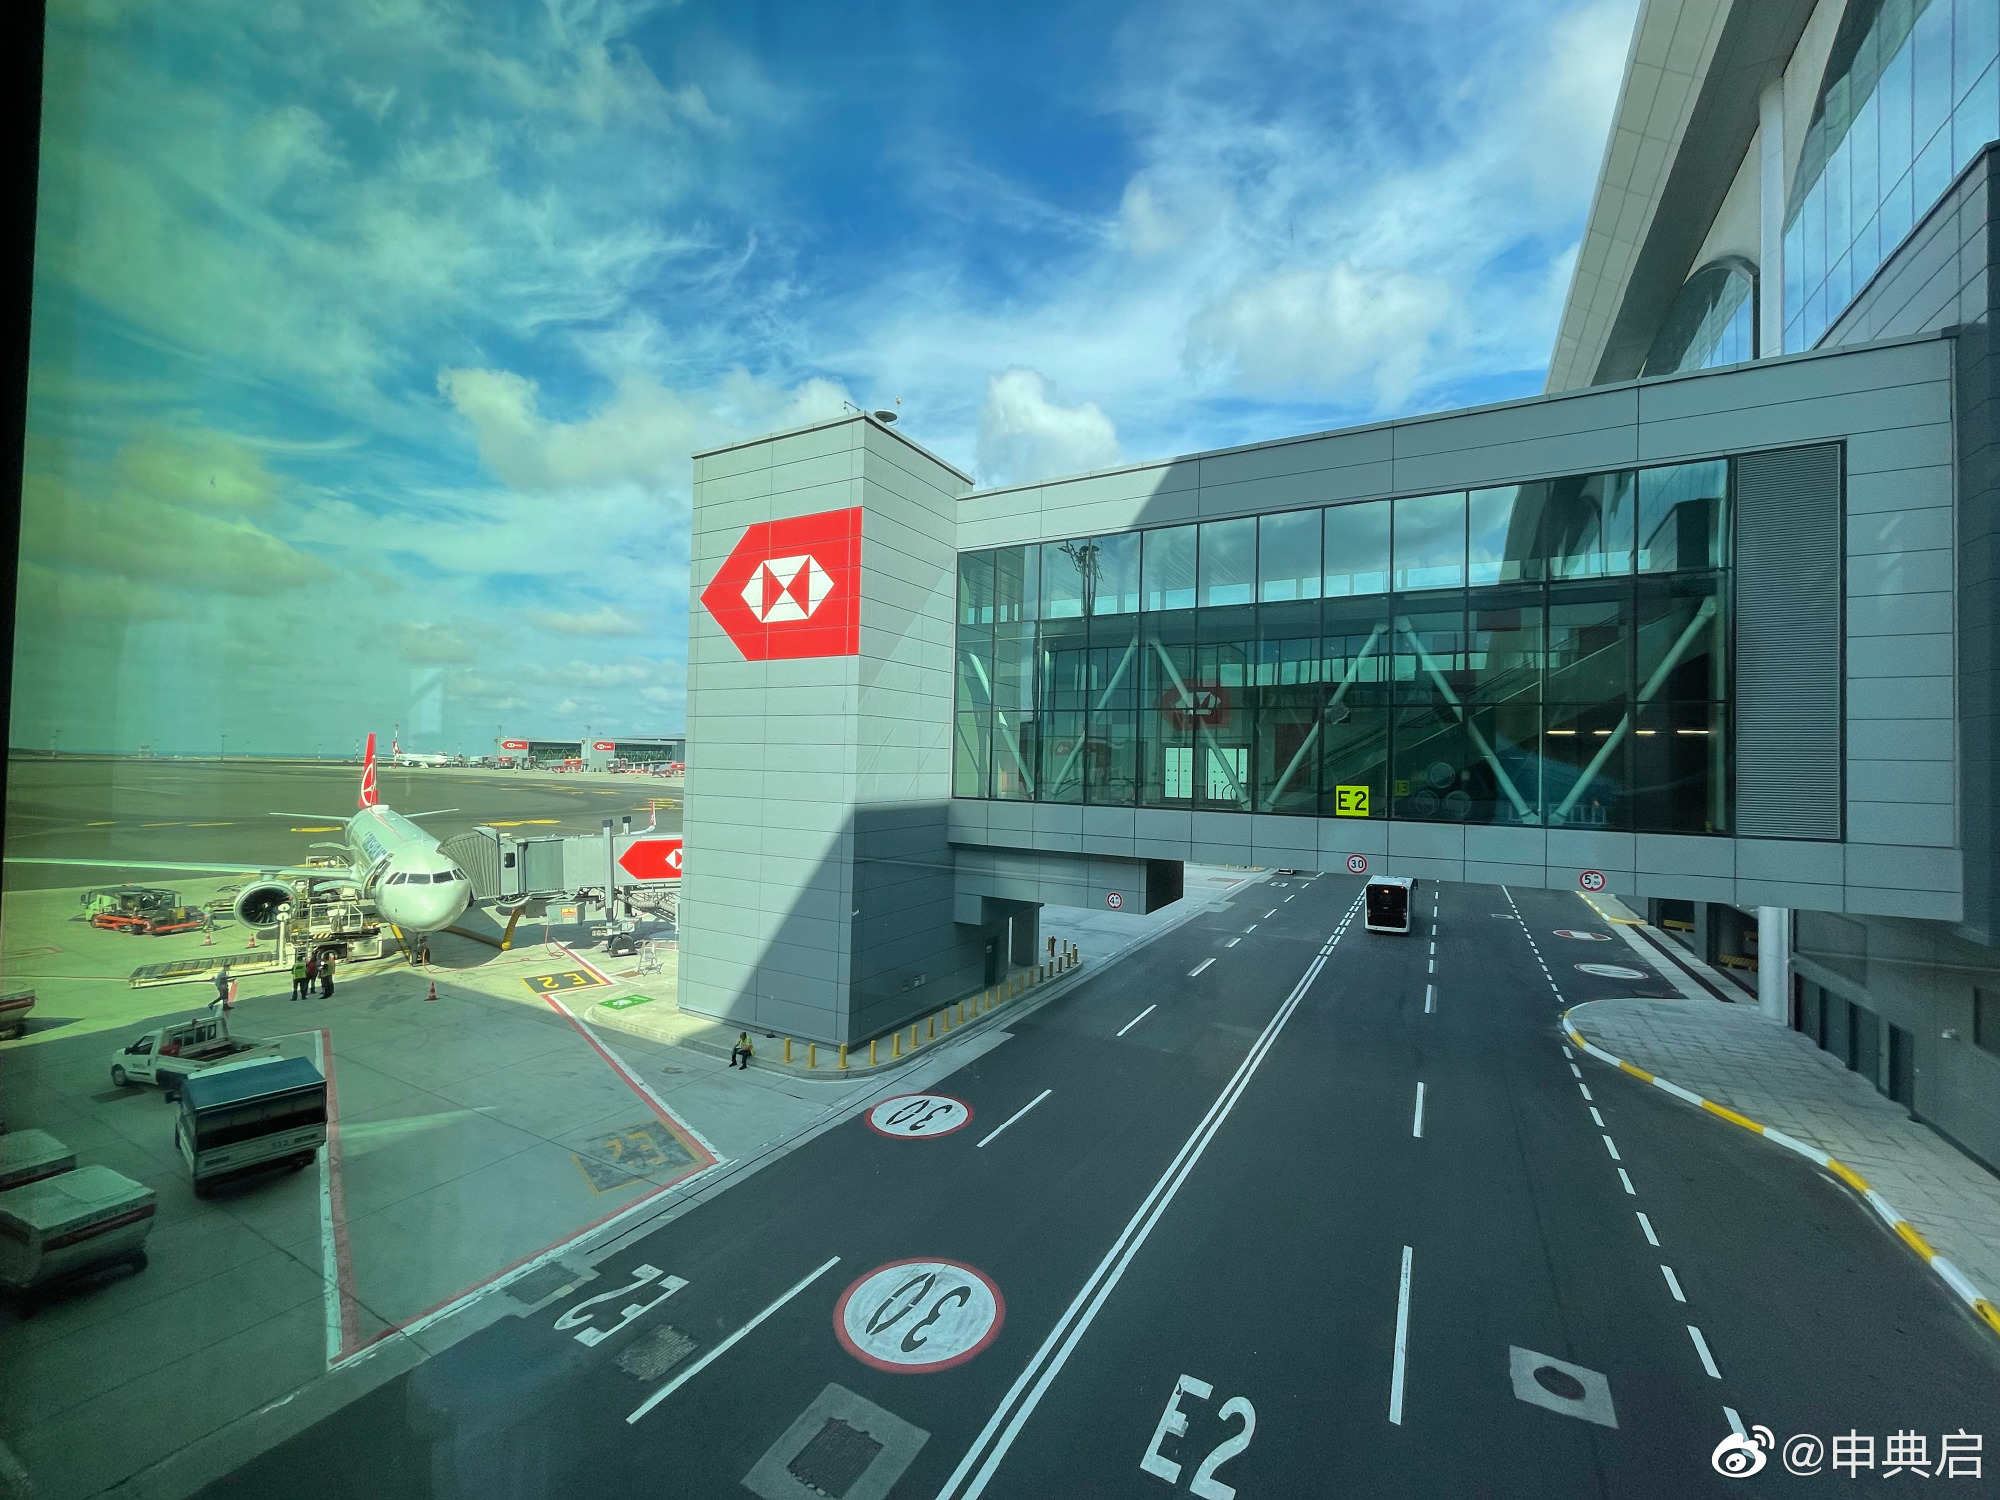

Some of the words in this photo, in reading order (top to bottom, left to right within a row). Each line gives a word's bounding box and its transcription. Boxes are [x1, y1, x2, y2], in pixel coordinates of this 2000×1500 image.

[1338, 790, 1367, 811] E2
[1350, 860, 1364, 869] 30
[537, 973, 587, 988] E2
[886, 1100, 953, 1130] 30
[553, 1263, 689, 1347] E2
[866, 1272, 972, 1352] 30
[1140, 1373, 1256, 1500] E2
